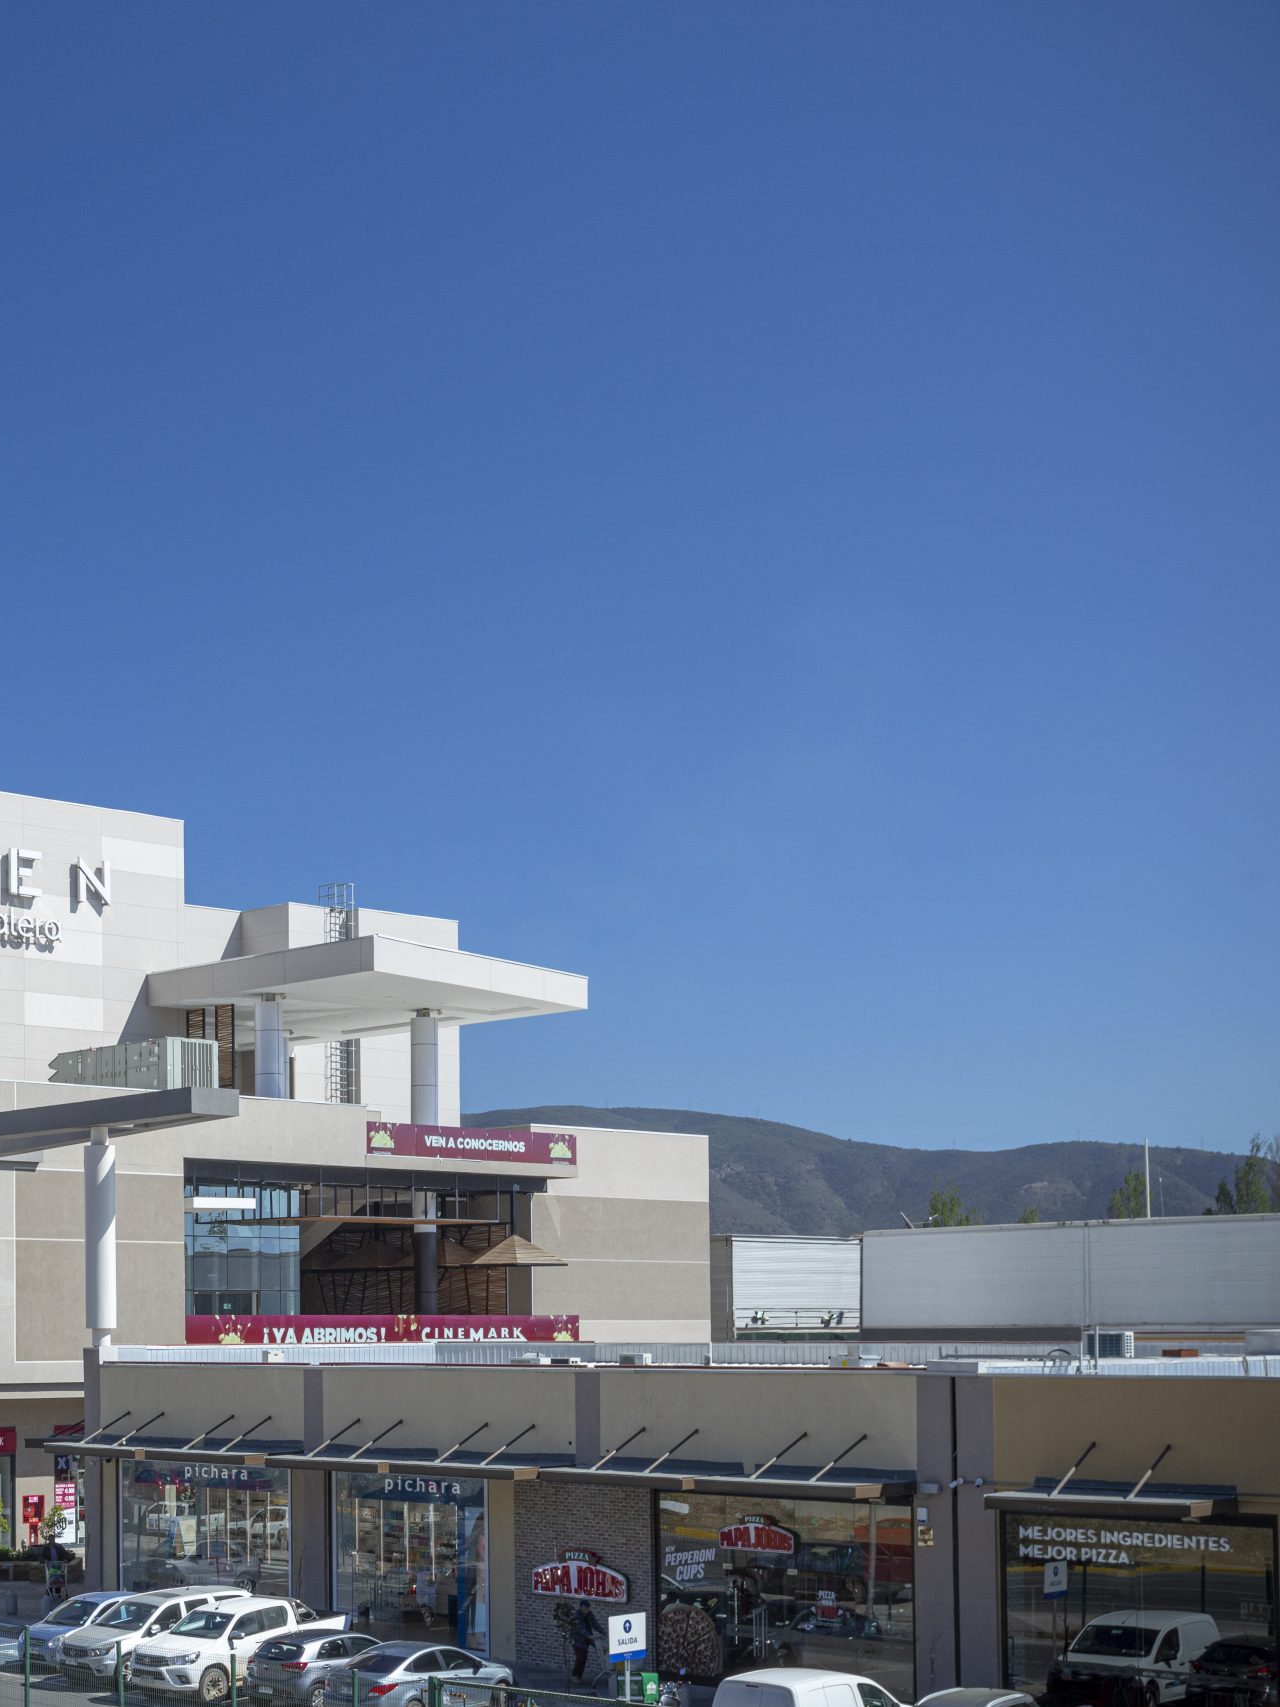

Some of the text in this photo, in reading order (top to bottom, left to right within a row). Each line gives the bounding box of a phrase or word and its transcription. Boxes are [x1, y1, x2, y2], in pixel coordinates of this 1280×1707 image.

[424, 1134, 526, 1153] VEN A CONOCERNOS
[421, 1327, 529, 1343] CINEMARK
[184, 1464, 248, 1481] pichara
[384, 1476, 461, 1495] pichara
[1018, 1525, 1234, 1552] MEJORES INGREDIENTES.
[565, 1551, 589, 1561] PIZZA
[665, 1548, 716, 1567] PEPPERONI
[1018, 1544, 1135, 1565] MEJOR PIZZA.
[675, 1563, 705, 1581] CUPS
[617, 1636, 638, 1646] SALIDA
